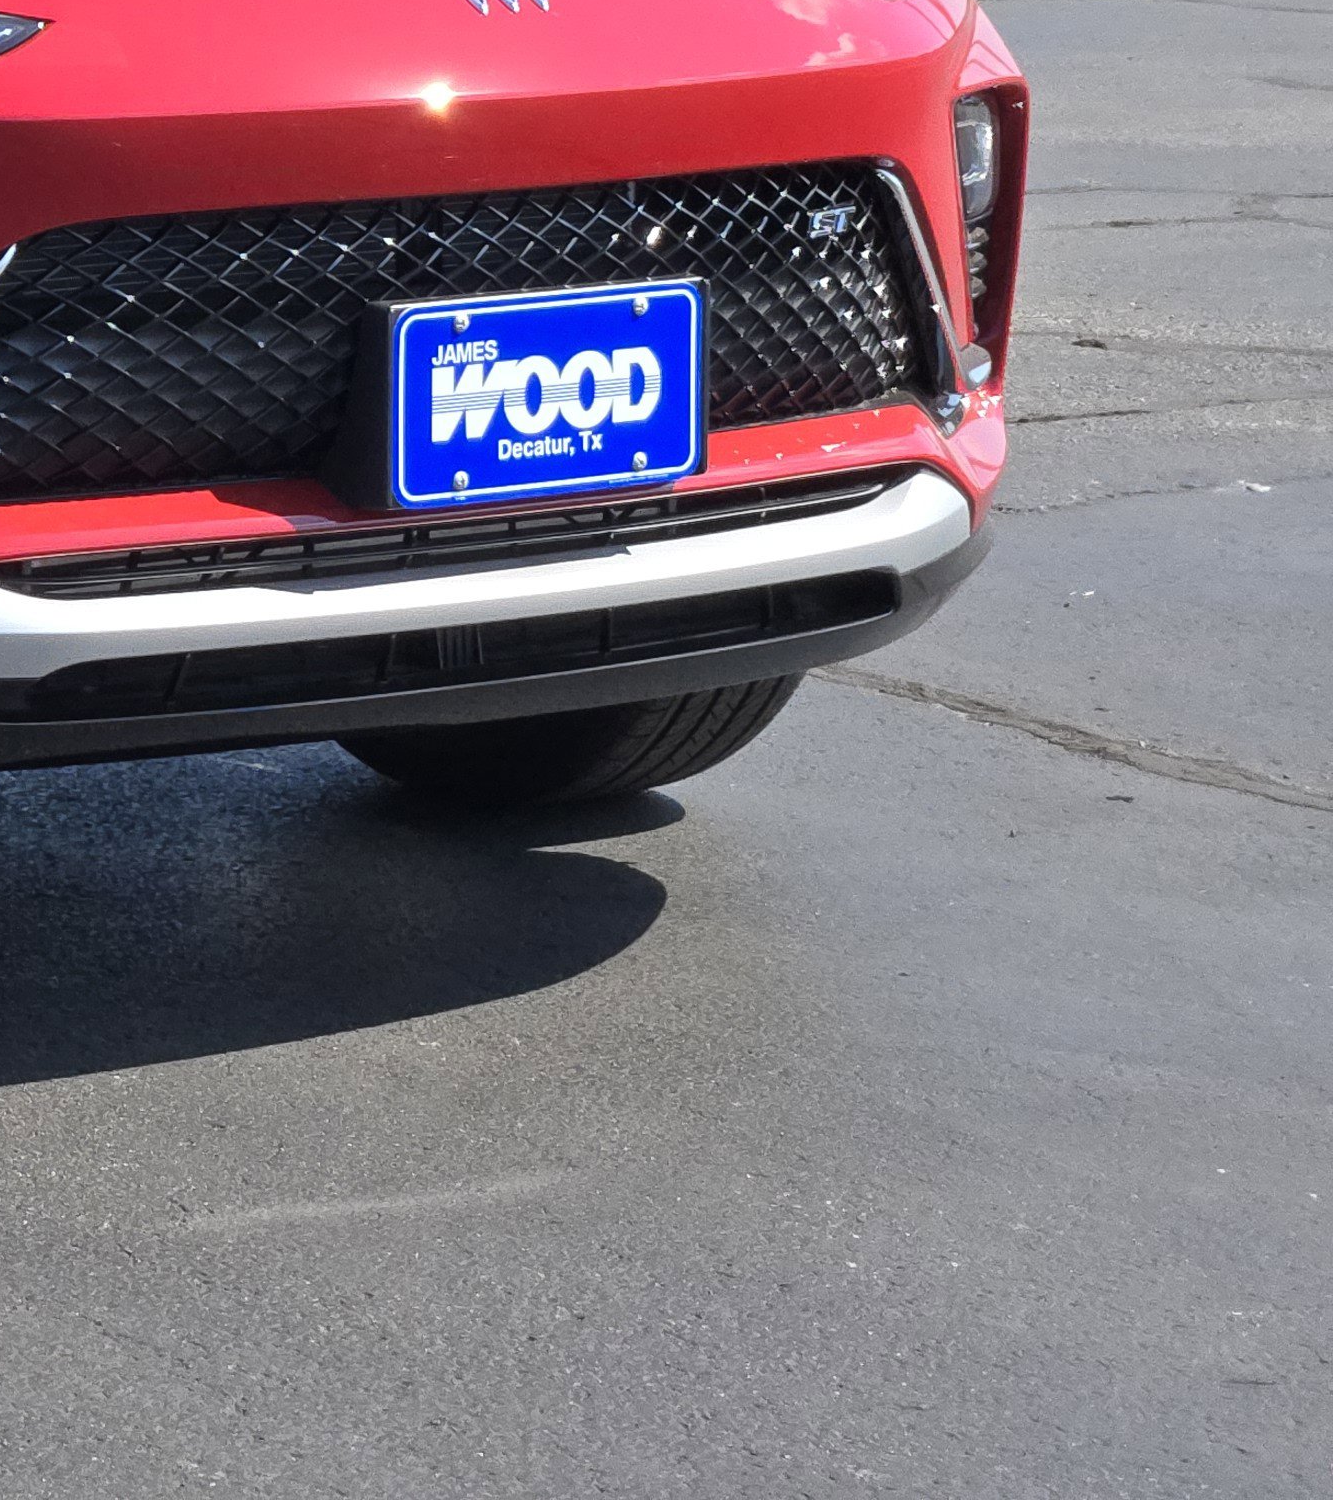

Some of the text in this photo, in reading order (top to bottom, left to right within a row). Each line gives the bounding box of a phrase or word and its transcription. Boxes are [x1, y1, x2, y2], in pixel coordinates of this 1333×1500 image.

[431, 339, 499, 366] JAMES
[431, 346, 662, 443] WOOD
[498, 430, 603, 461] Decatur, Tx
